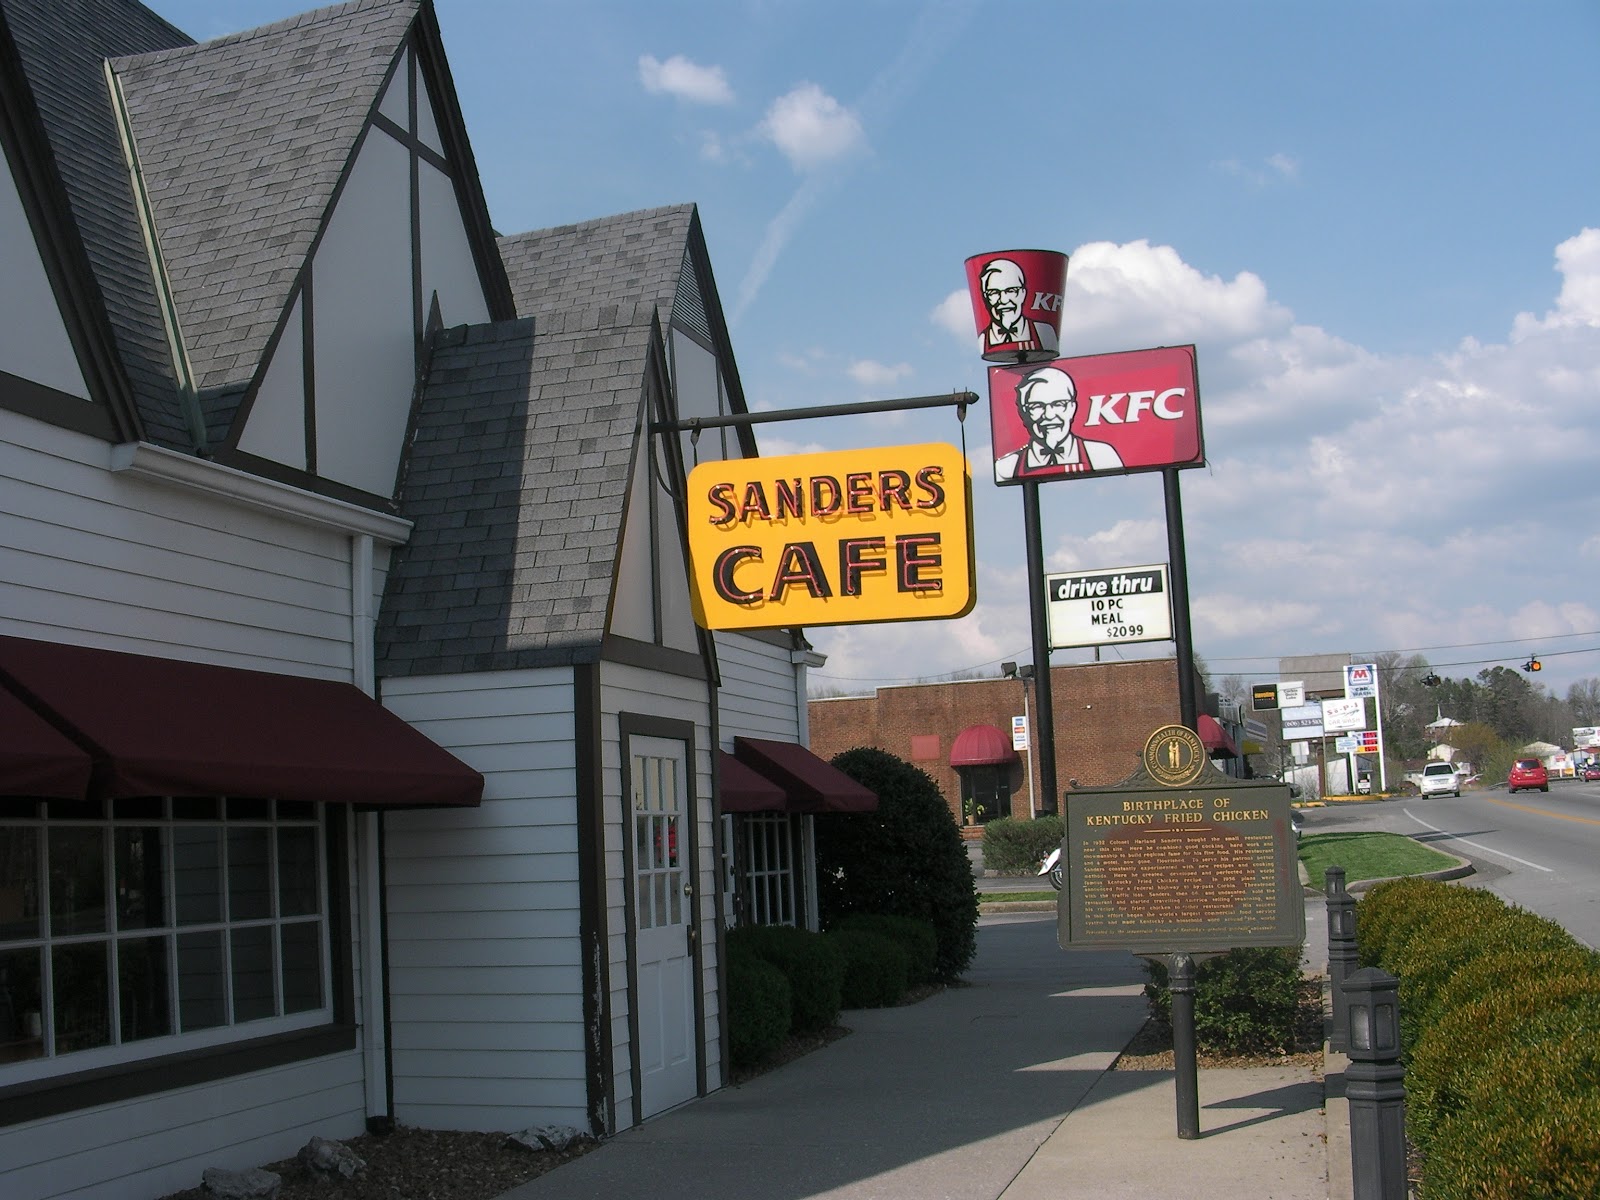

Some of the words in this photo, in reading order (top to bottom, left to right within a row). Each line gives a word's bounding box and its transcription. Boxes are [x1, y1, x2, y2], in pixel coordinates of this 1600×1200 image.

[1084, 387, 1186, 427] KFC
[708, 466, 946, 526] SANDERS
[712, 532, 943, 605] CAFE
[1058, 578, 1107, 599] drive
[1111, 575, 1153, 594] thru
[1091, 600, 1105, 611] 10
[1108, 598, 1123, 610] PC
[1091, 612, 1124, 625] MEAL
[1122, 798, 1204, 812] BIRTHPLACE
[1213, 798, 1230, 808] OF
[1086, 814, 1154, 826] KENTUCKY
[1164, 813, 1203, 824] FRIED
[1212, 810, 1269, 821] CHICKEN
